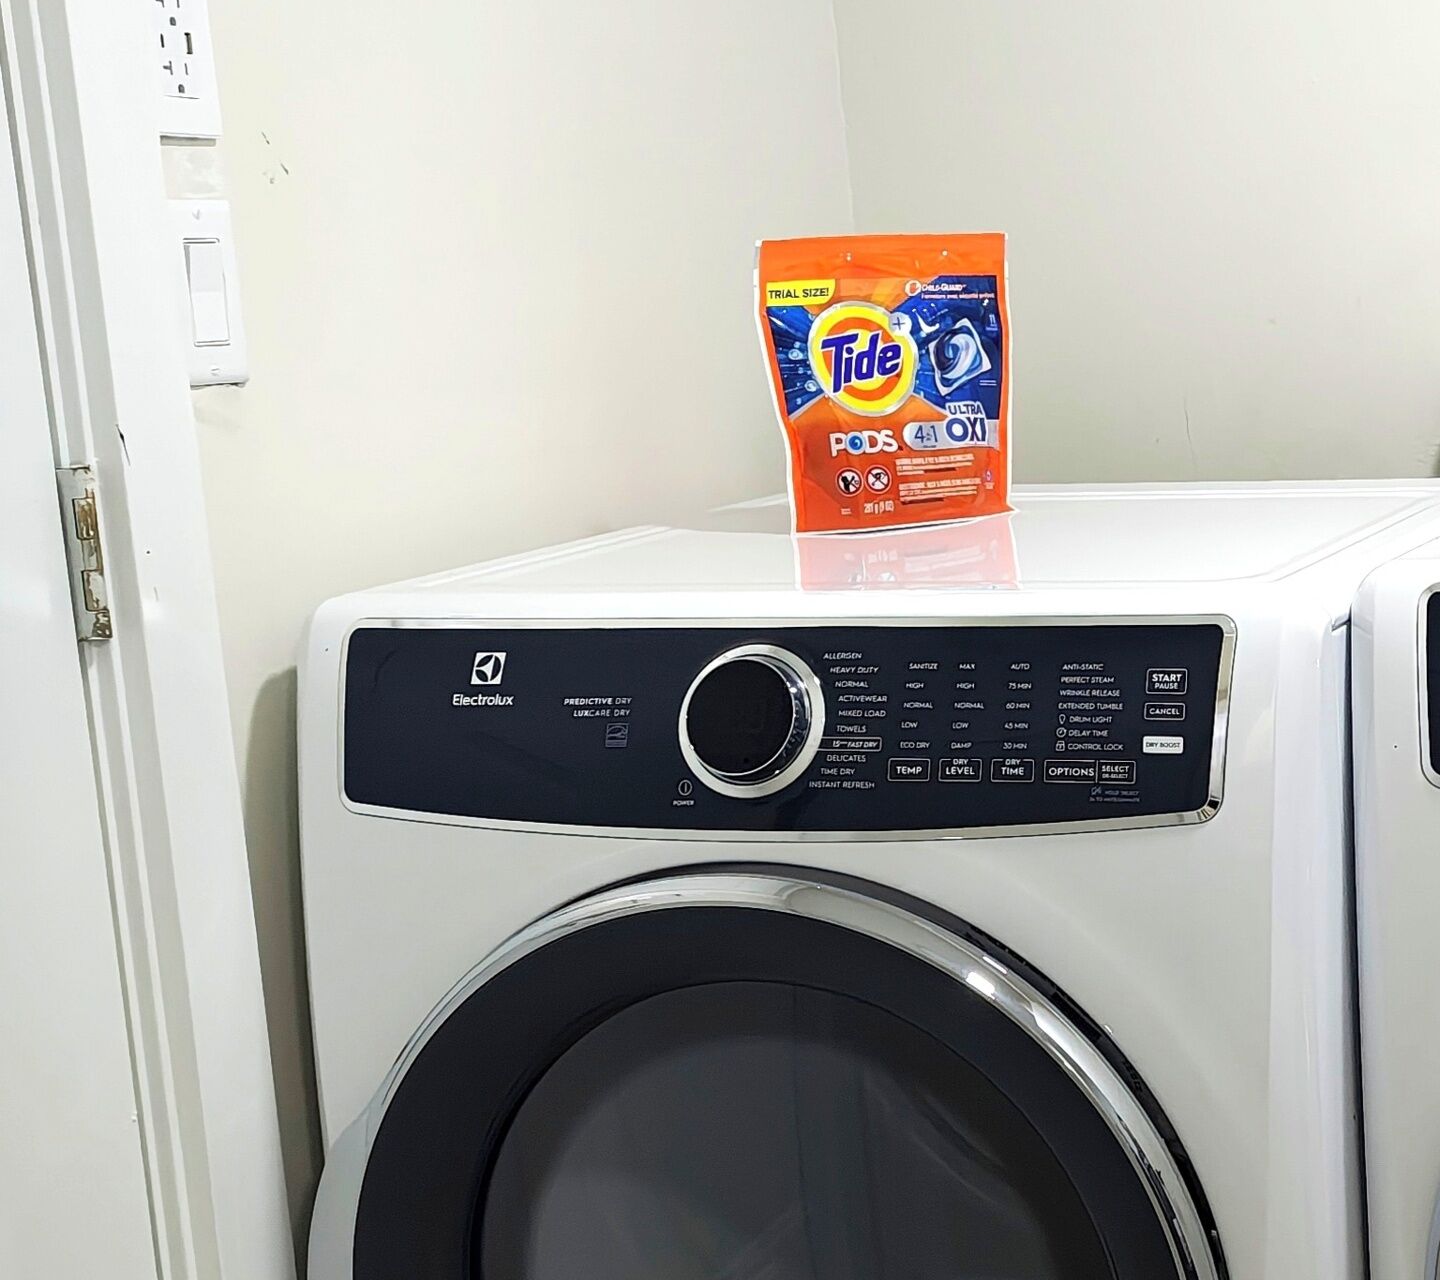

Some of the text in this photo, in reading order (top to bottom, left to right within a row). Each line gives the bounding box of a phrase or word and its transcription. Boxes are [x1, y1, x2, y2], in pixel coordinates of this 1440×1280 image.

[768, 288, 829, 299] TRIAL SIZE!
[821, 331, 902, 395] Tide
[947, 404, 983, 416] ULTRA
[946, 417, 987, 442] OXI
[829, 430, 899, 456] PODS
[1152, 673, 1182, 682] START
[452, 694, 515, 706] Electrolux
[573, 709, 631, 717] LUXCARE DRY
[837, 725, 866, 733] TOWELS
[896, 766, 923, 775] TEMP
[945, 766, 975, 775] LEVEL
[1001, 767, 1025, 775] TIME
[1048, 767, 1095, 777] OPTIONS
[1102, 765, 1129, 773] SELECT
